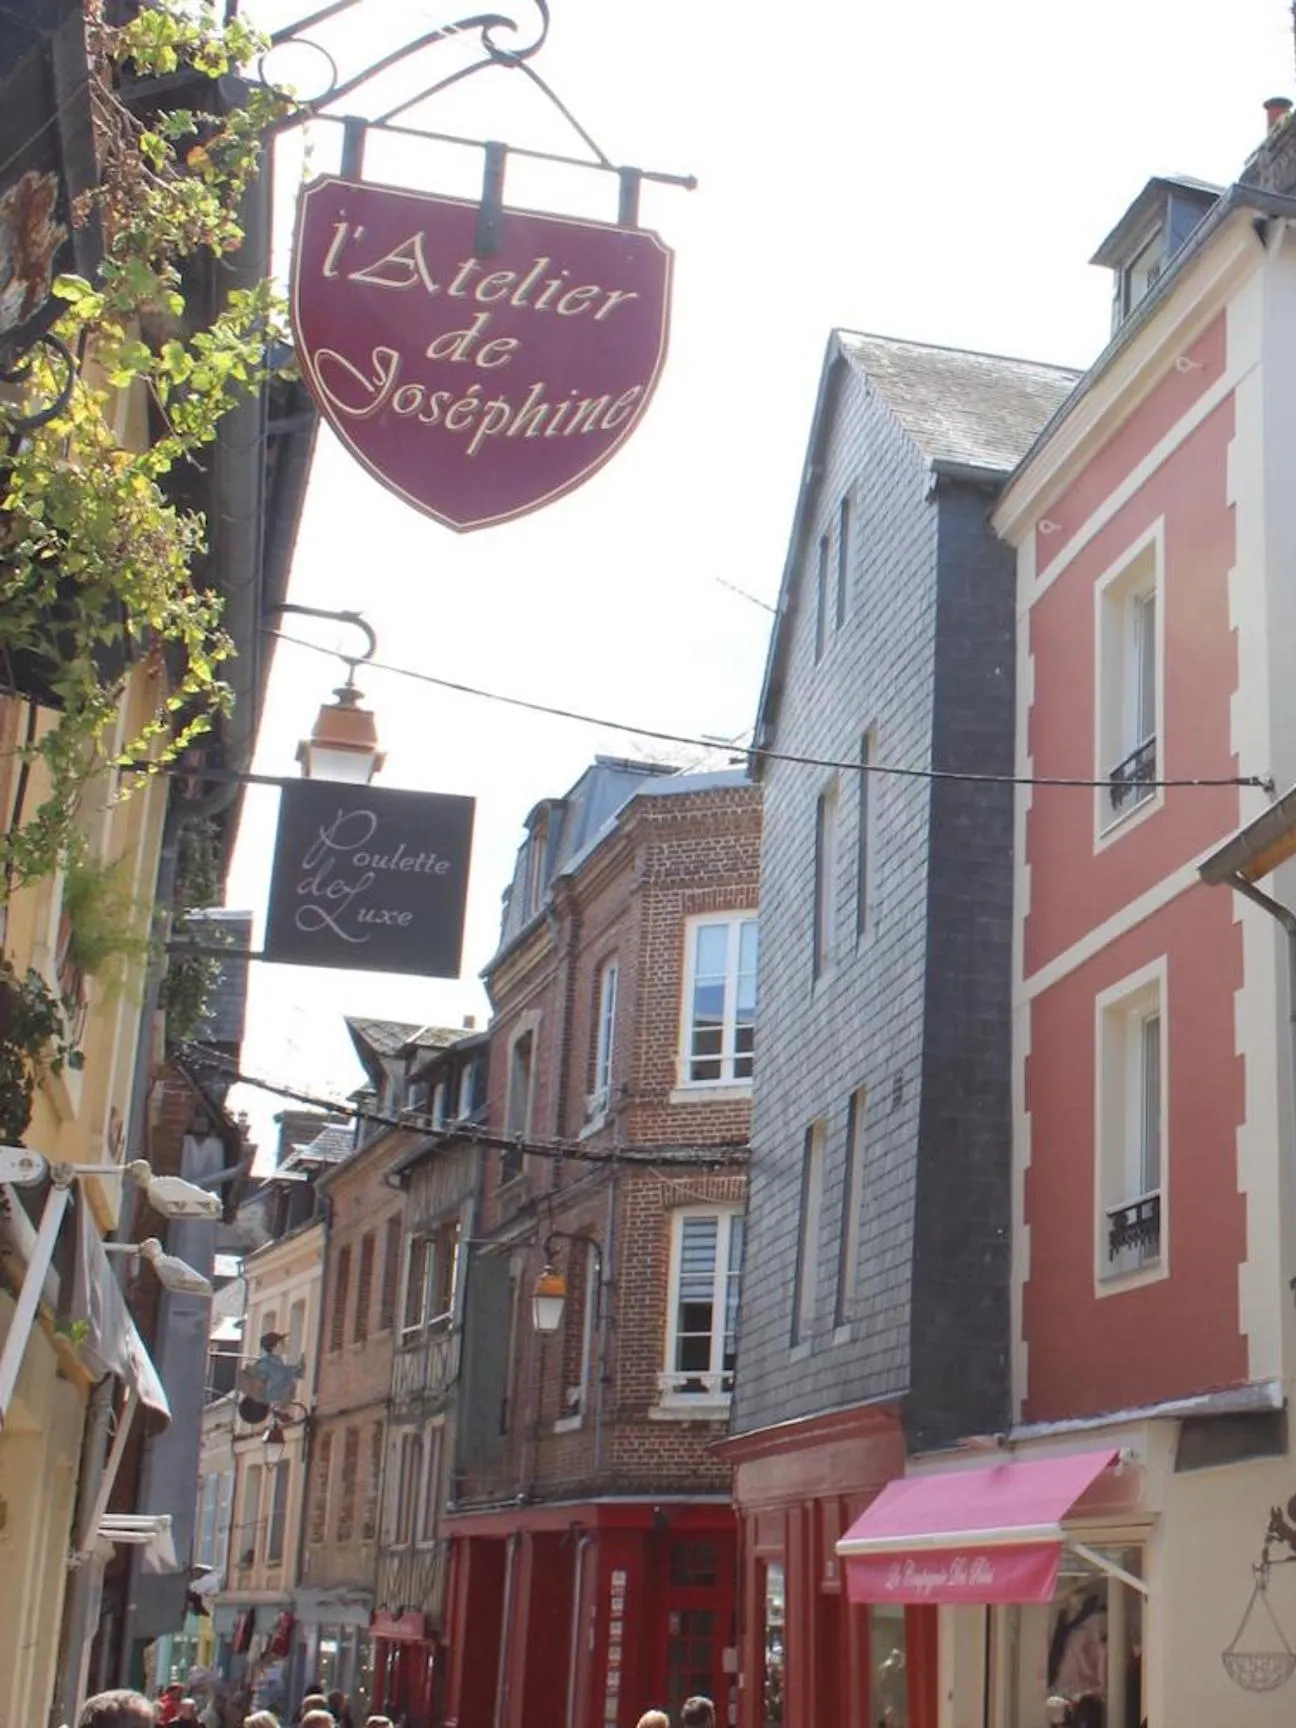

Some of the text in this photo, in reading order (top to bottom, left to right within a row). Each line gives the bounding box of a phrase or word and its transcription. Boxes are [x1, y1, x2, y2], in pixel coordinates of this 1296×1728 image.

[425, 312, 522, 368] de
[314, 346, 644, 455] Joséphine
[303, 808, 450, 875] Poulette
[296, 872, 413, 943] Luxe
[297, 857, 348, 899] de
